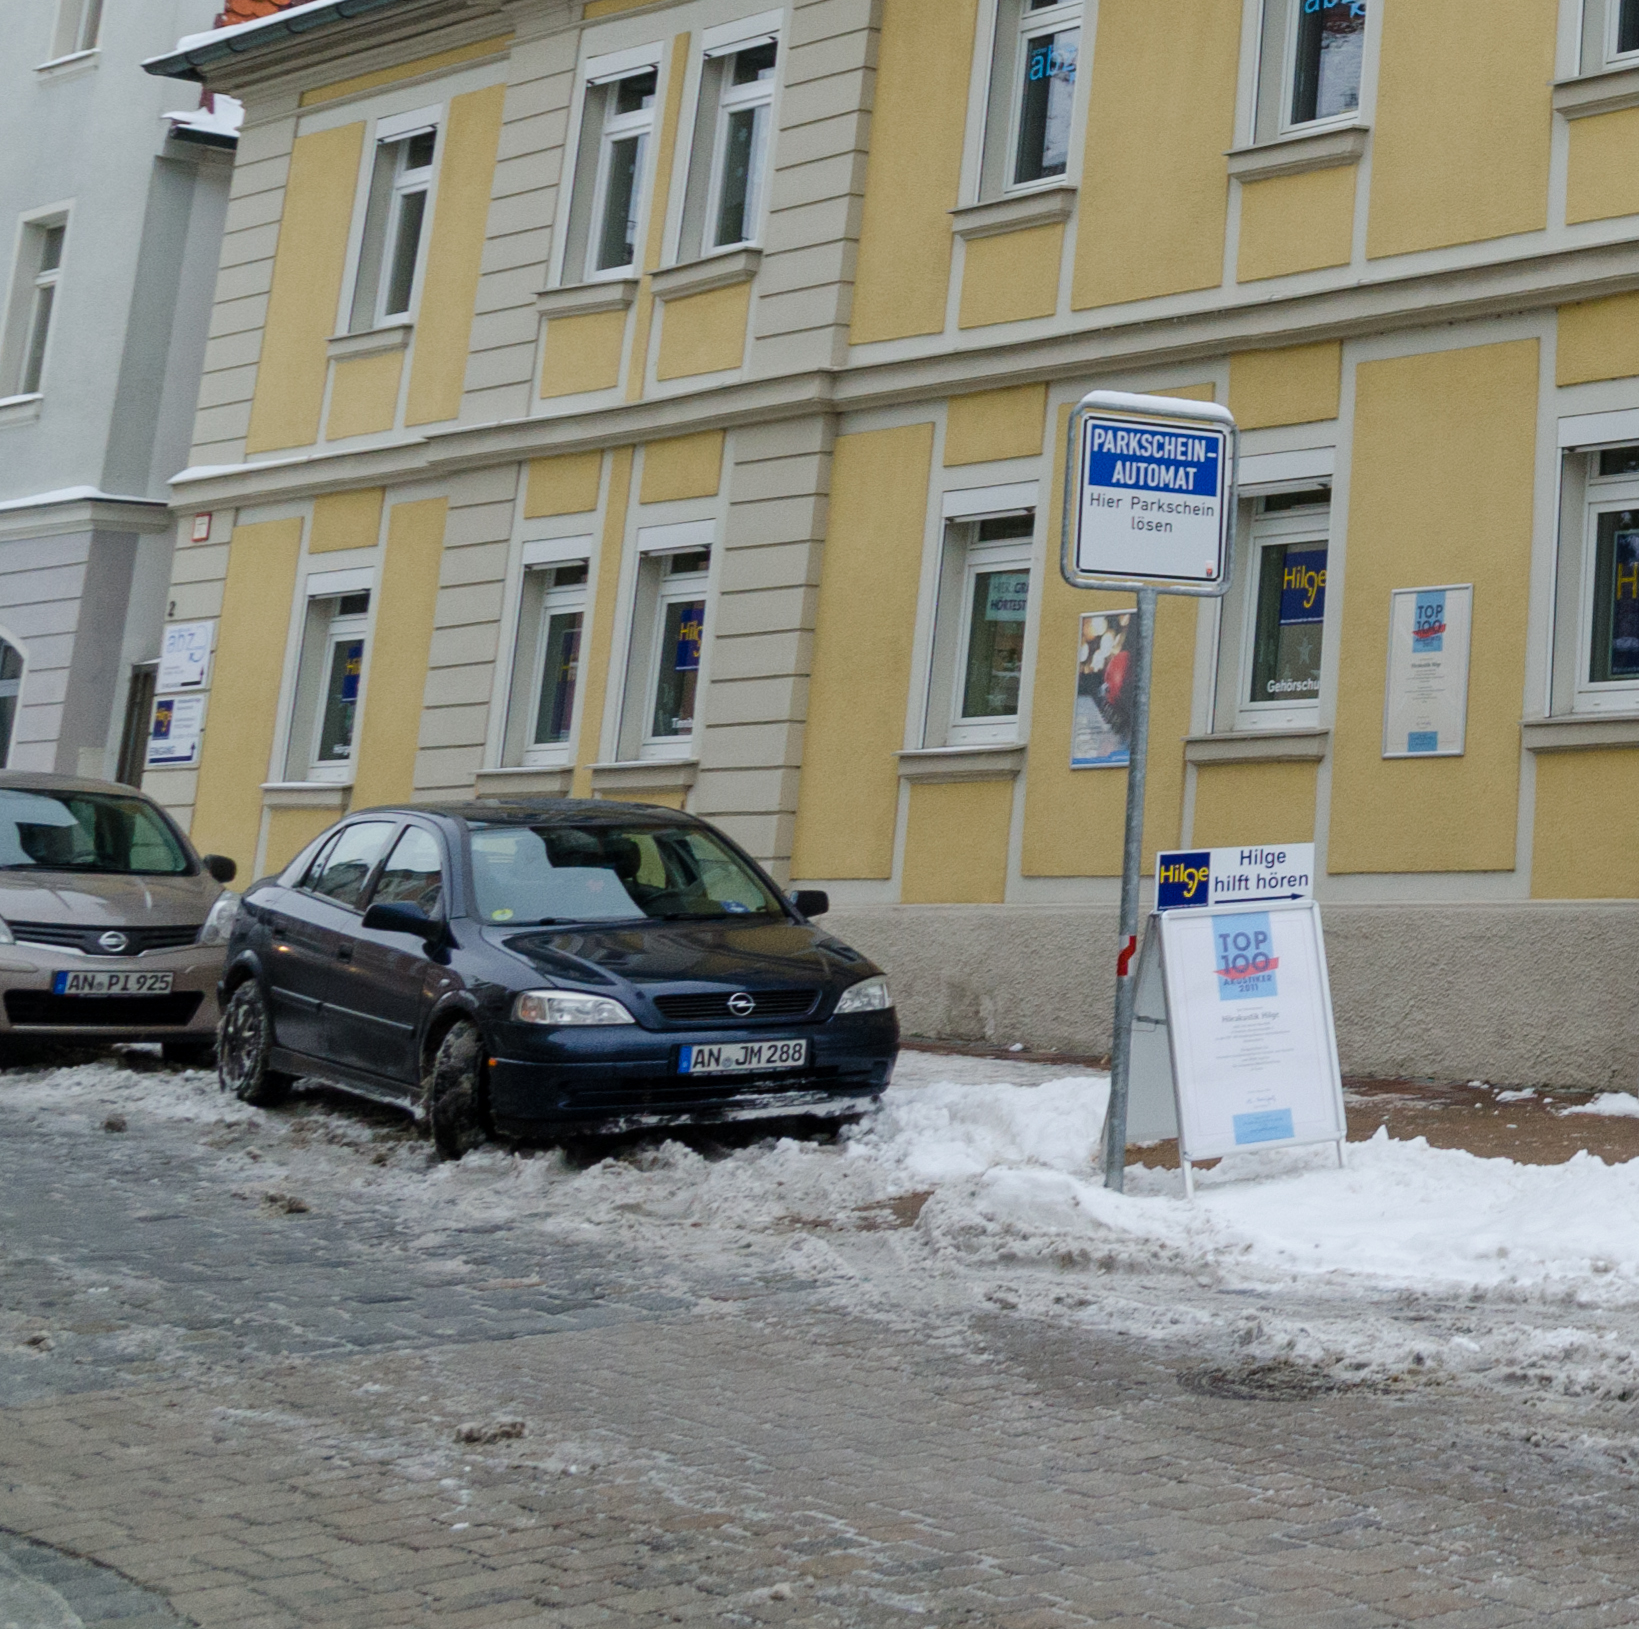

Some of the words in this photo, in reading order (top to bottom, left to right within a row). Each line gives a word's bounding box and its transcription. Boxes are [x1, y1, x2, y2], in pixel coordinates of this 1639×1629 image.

[1093, 428, 1217, 463] PARKSCHEIN-
[1112, 460, 1197, 490] AUTOMAT
[1090, 492, 1123, 508] Hier
[1131, 496, 1214, 517] Parkschein
[1131, 516, 1173, 532] lösen
[1283, 566, 1327, 608] Hilge
[168, 601, 176, 617] 2
[1418, 604, 1443, 619] TOP
[1240, 849, 1286, 868] Hilge
[1160, 863, 1209, 898] Hilge
[1214, 874, 1250, 893] hilft
[1256, 872, 1309, 890] hören
[1219, 931, 1268, 953] TOP
[1221, 952, 1270, 974] 100
[68, 974, 95, 991] AN
[107, 974, 130, 991] PI
[136, 974, 172, 991] 925
[693, 1047, 722, 1068] AN
[735, 1045, 763, 1066] JM
[765, 1043, 803, 1064] 288
